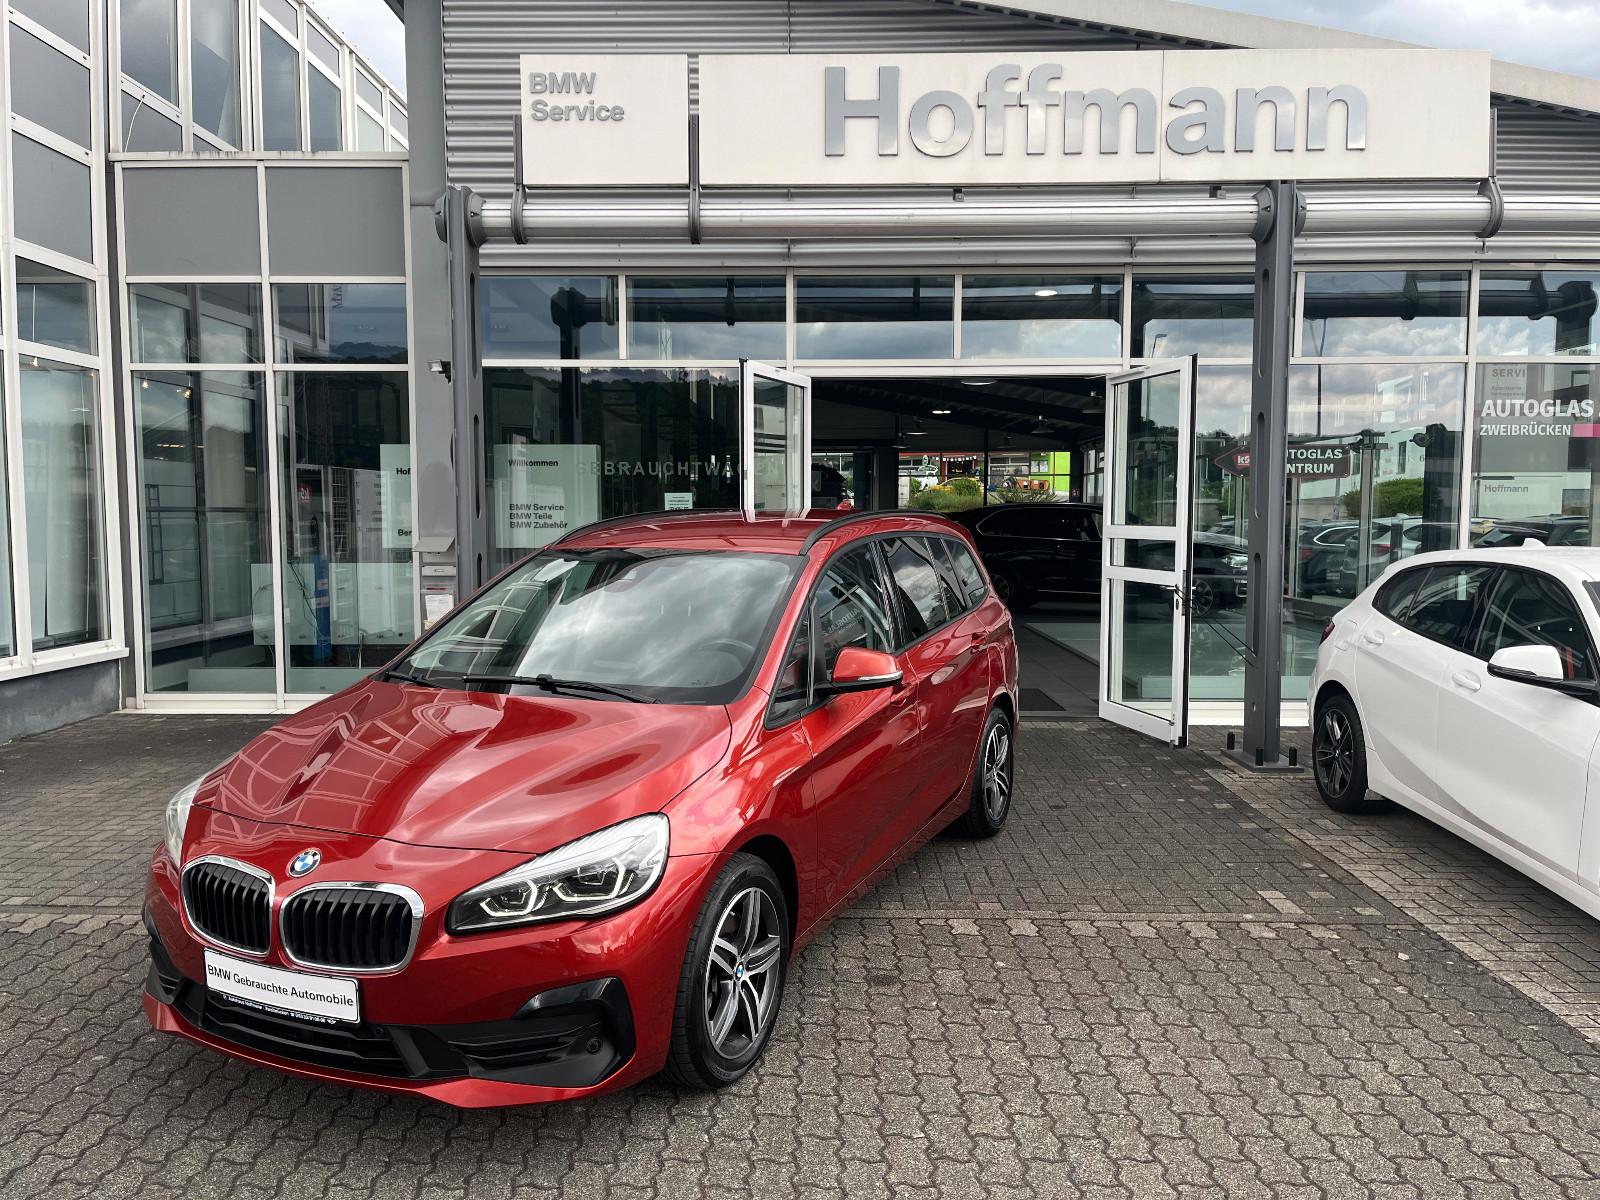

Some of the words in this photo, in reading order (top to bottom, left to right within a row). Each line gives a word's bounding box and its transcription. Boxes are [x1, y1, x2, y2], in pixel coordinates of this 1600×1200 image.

[529, 71, 597, 95] BMW
[530, 98, 625, 122] Service
[824, 62, 1369, 158] Hoffmann
[1481, 398, 1595, 418] AUTOGLAS
[1479, 421, 1572, 436] ZWEIBRÜCKEN
[1286, 448, 1343, 460] TOGLAS
[1286, 463, 1334, 474] NTRUM
[1484, 484, 1529, 493] Hoffmann
[509, 503, 532, 511] BMW
[533, 503, 565, 511] Service
[509, 512, 532, 520] BMW
[533, 512, 553, 520] Teile
[510, 521, 532, 529] BMW
[533, 520, 568, 529] Zubehör
[208, 963, 231, 981] BMW
[233, 973, 289, 995] Gebrauchte
[291, 987, 355, 1006] Automobile
